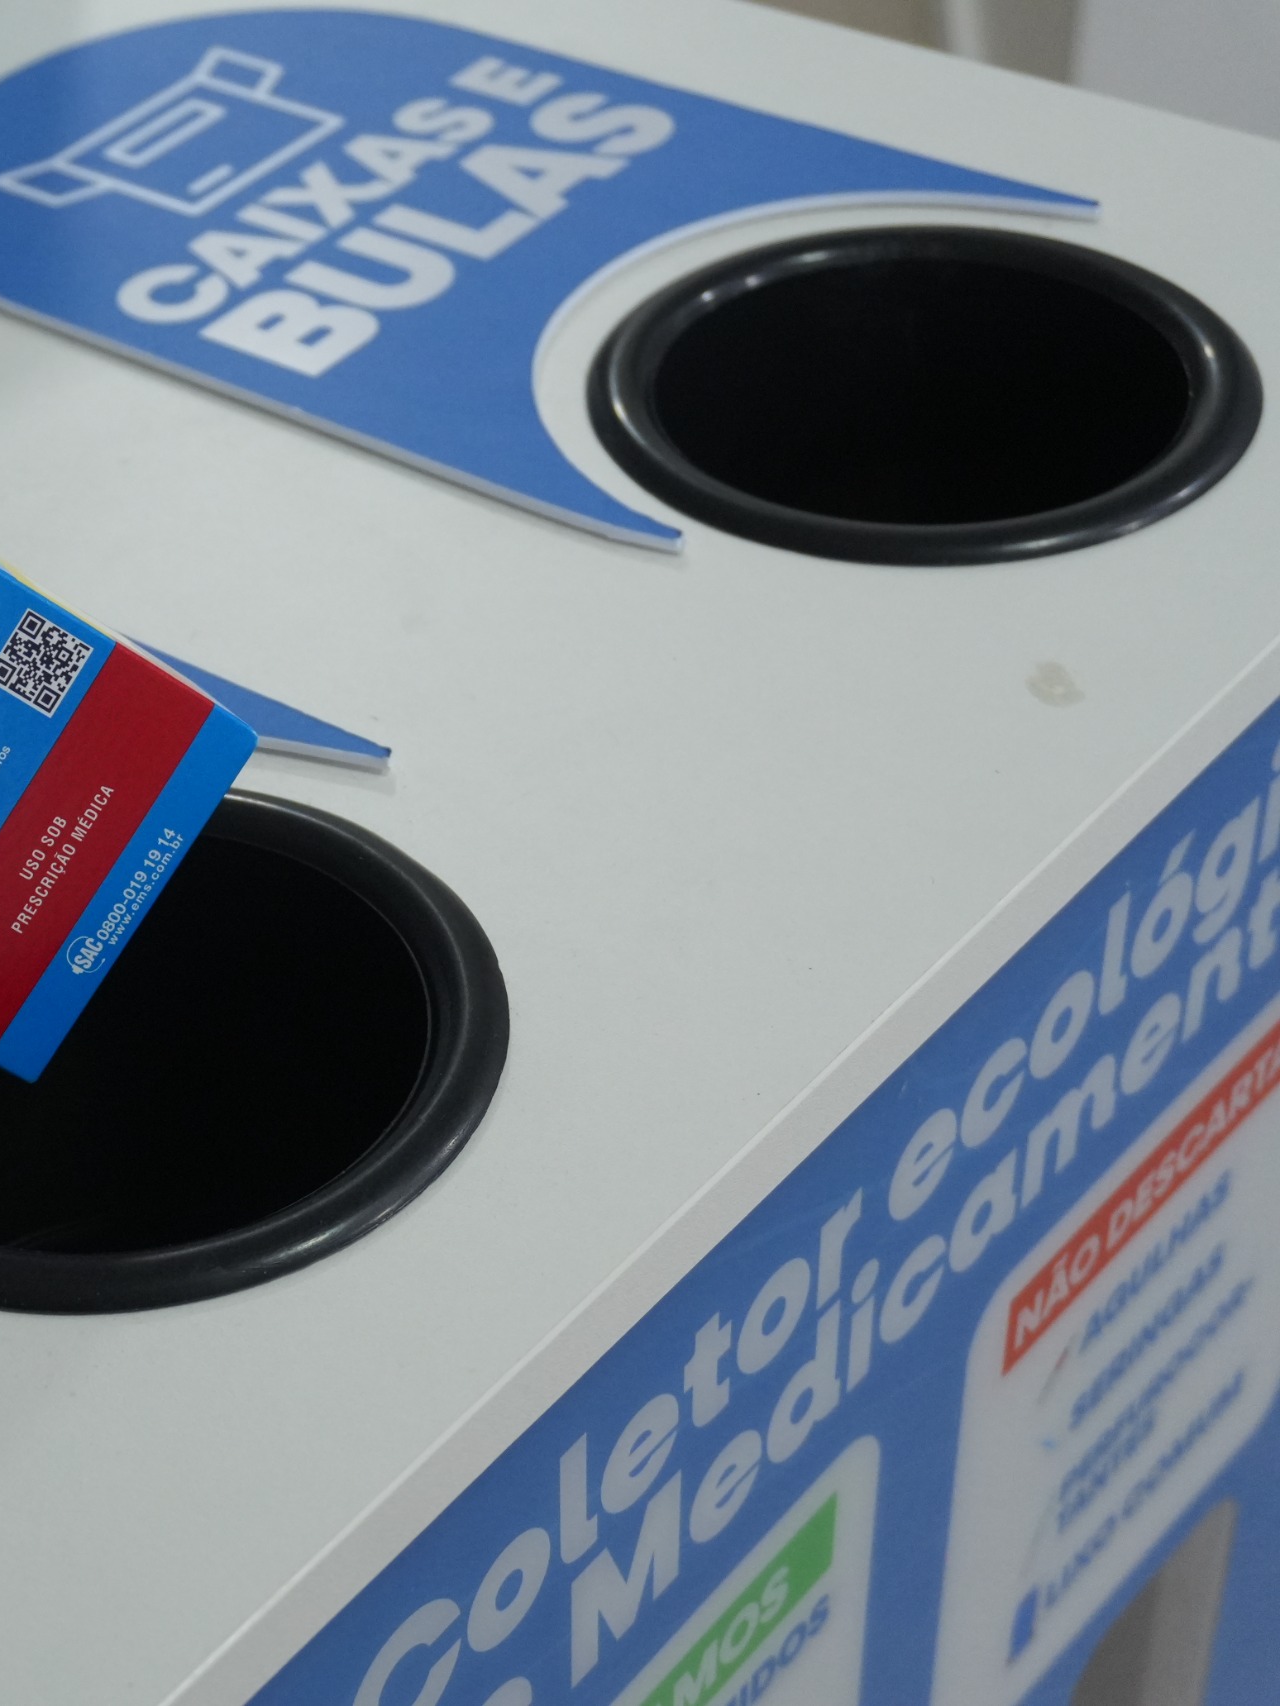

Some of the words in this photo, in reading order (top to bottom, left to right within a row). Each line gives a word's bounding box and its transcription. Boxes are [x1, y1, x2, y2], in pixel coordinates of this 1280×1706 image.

[117, 98, 495, 324] CAIXAS
[449, 56, 564, 107] E
[198, 92, 675, 377] BULAS
[10, 843, 76, 934] PRESCRIÇÃO
[70, 785, 114, 842] MÉDICA
[18, 848, 45, 880] USO
[40, 816, 66, 847] SOB
[74, 937, 103, 969] SAC
[96, 870, 147, 941] 0800-019
[144, 849, 161, 867] 19
[157, 828, 176, 846] 14
[108, 833, 183, 945] www.ems.com.br
[1012, 1234, 1101, 1352] NÃO
[350, 1188, 863, 1706] Coletor
[657, 1566, 790, 1706] MOS
[727, 1593, 830, 1706] IDOS
